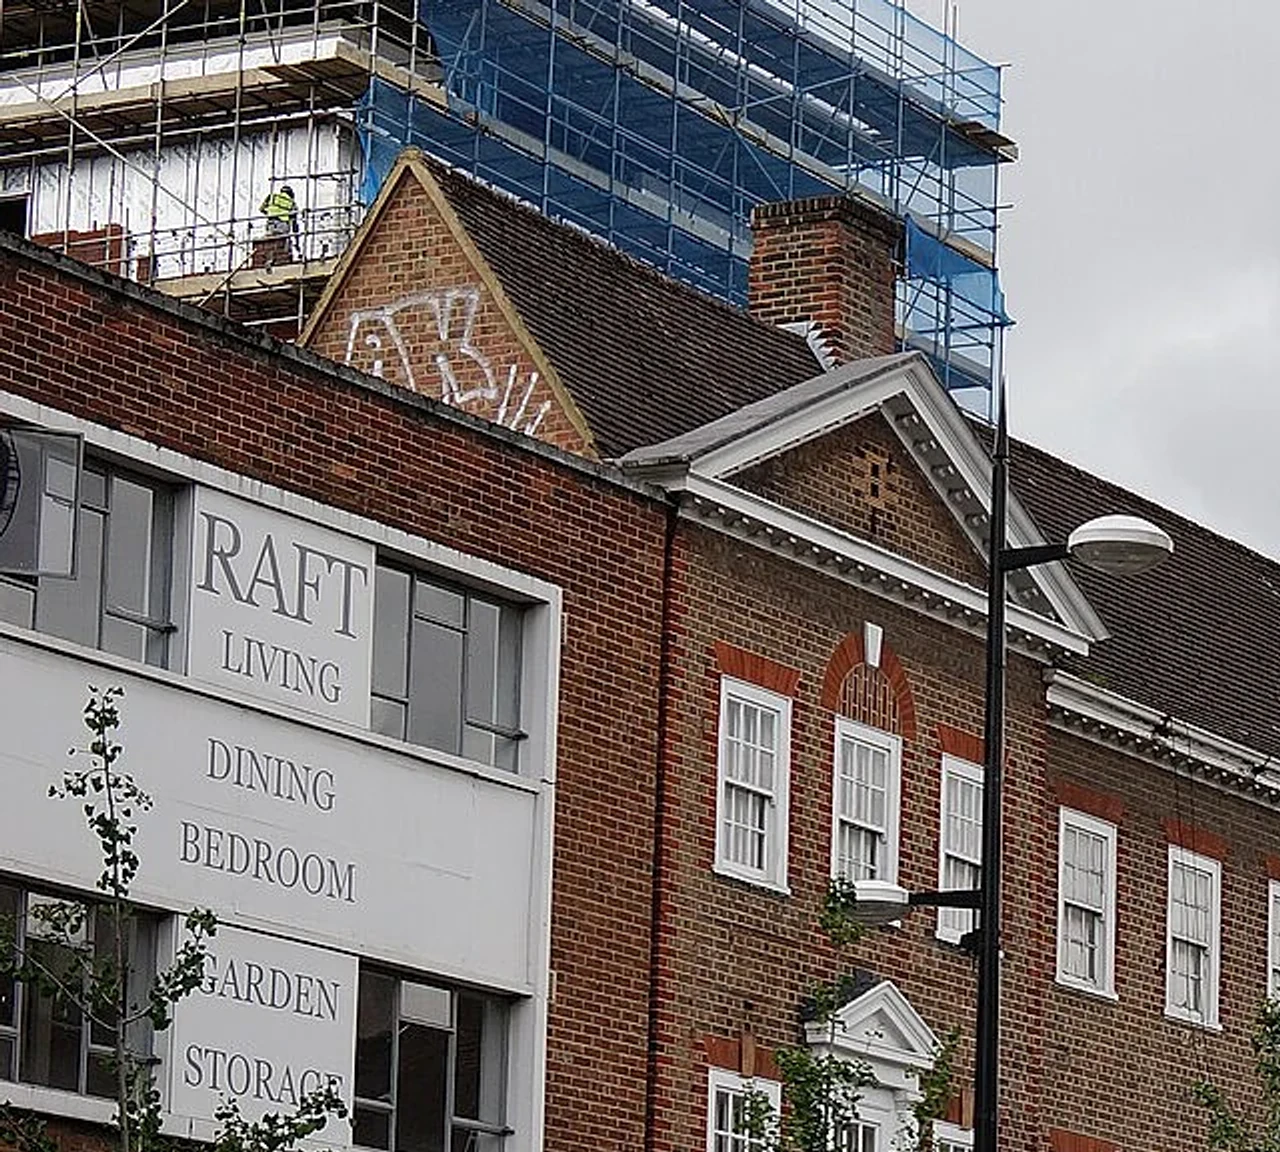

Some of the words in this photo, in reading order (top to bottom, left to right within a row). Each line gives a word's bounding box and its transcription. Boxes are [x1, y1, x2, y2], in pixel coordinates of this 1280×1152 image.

[196, 510, 369, 640] RAFT
[221, 630, 342, 704] LIVING
[206, 736, 337, 812] DINING
[179, 821, 357, 905] BEDROOM
[198, 952, 341, 1021] GARDEN
[184, 1044, 343, 1108] STORAG
